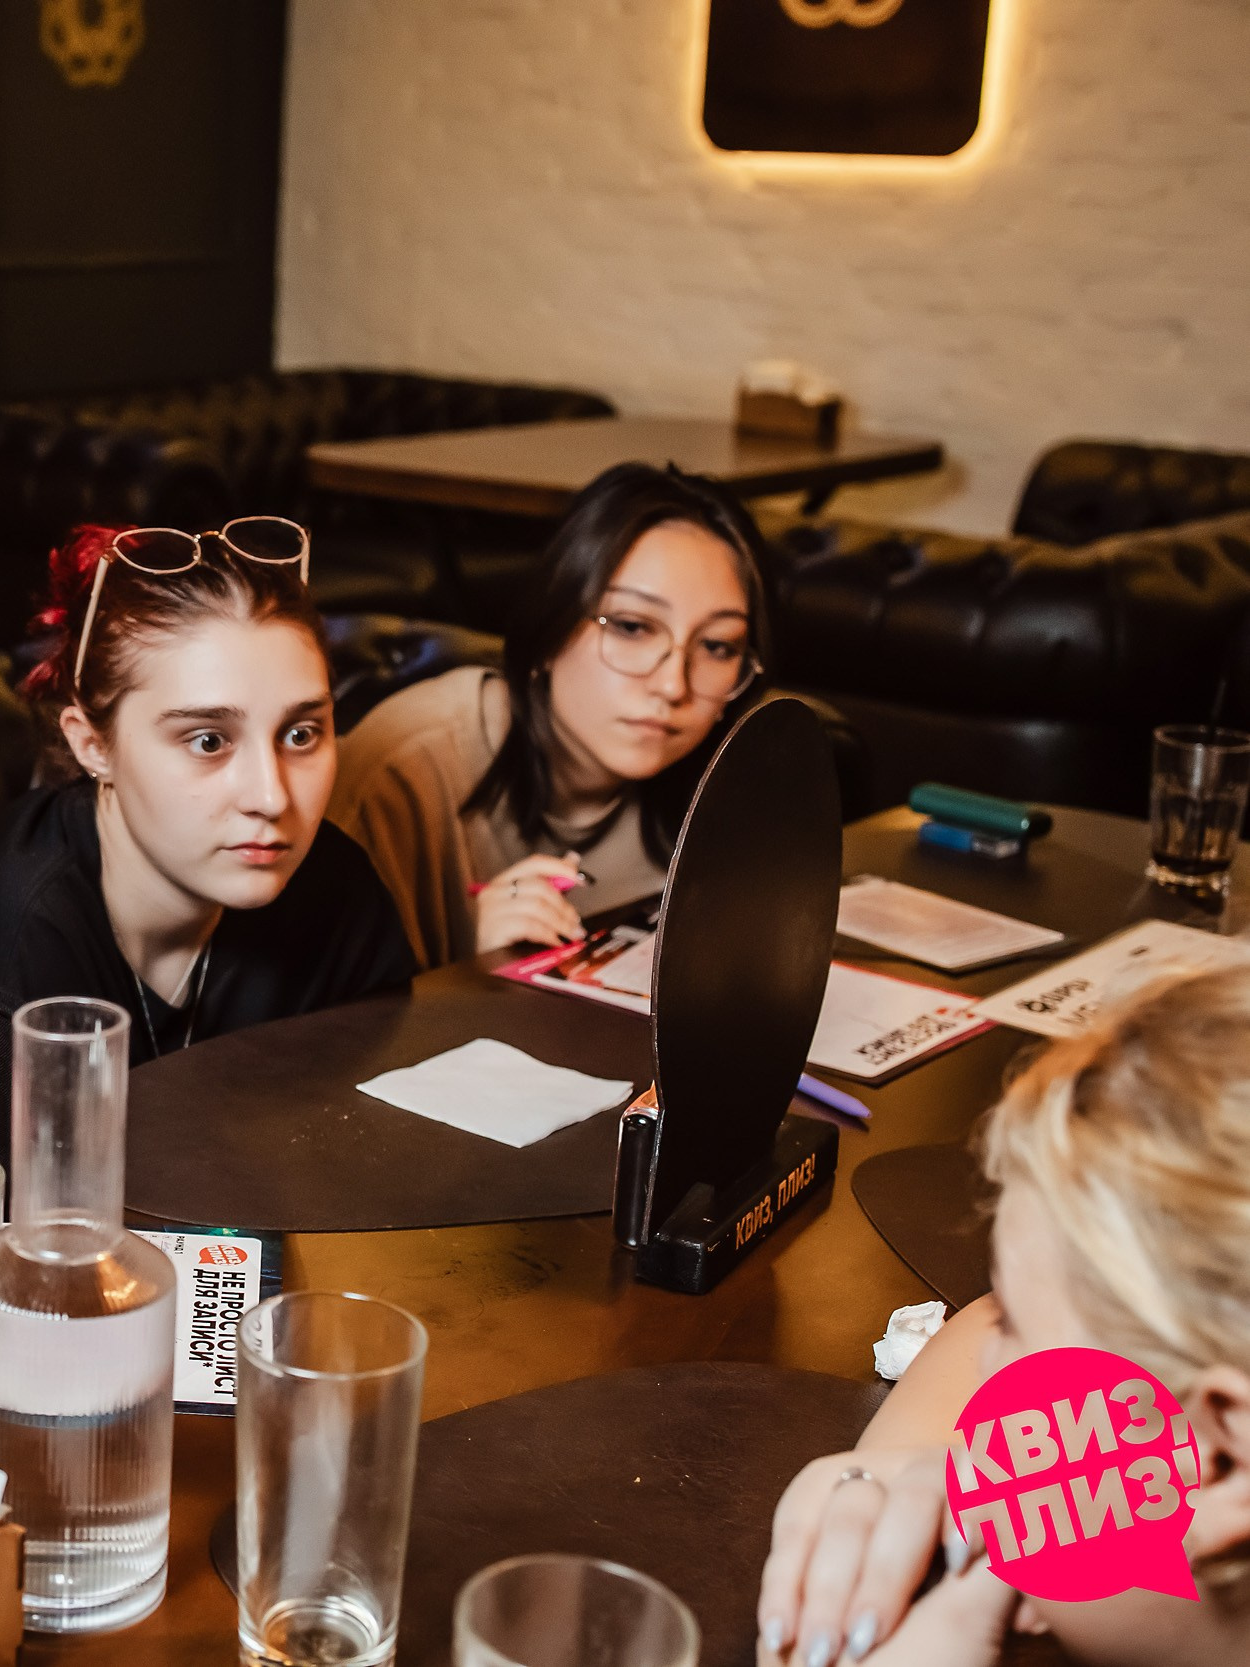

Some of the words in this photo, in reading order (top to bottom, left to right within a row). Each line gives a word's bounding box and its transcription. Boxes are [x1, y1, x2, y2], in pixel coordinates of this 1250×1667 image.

[735, 1195, 773, 1250] КВИЗ,
[777, 1152, 815, 1211] ПЛИЗ!
[193, 1268, 220, 1298] ДЛЯ
[222, 1271, 246, 1289] НЕ
[214, 1354, 238, 1398] ЛИСТ
